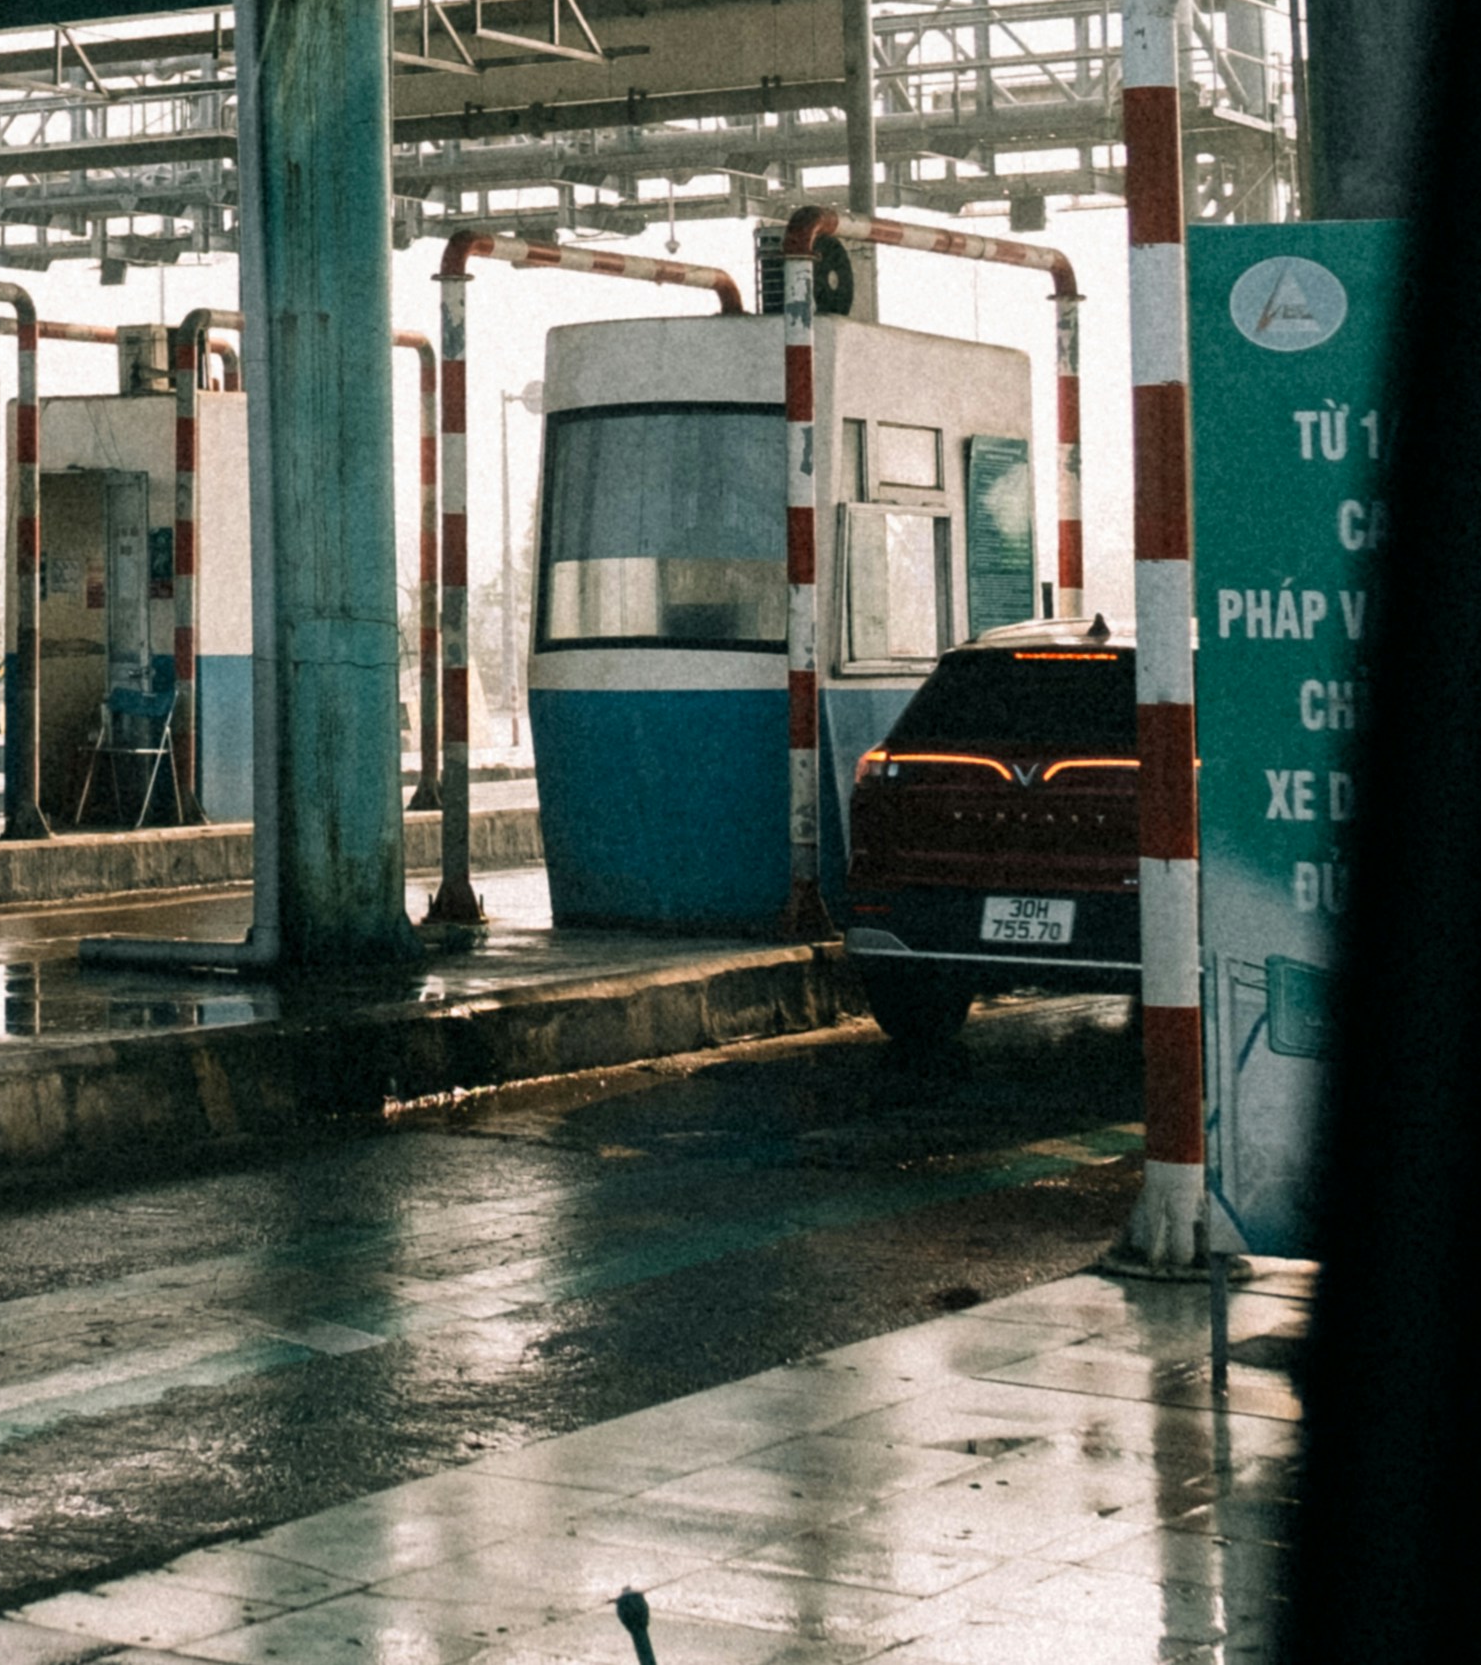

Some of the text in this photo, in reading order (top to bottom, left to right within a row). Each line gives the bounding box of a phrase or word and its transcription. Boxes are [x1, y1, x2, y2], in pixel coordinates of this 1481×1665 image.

[1293, 398, 1350, 461] TỪ
[1217, 577, 1328, 640] PHÁP
[1299, 679, 1355, 731] CH
[1264, 768, 1317, 822] XE
[992, 919, 1062, 941] 755.70
[1008, 899, 1049, 919] 30H
